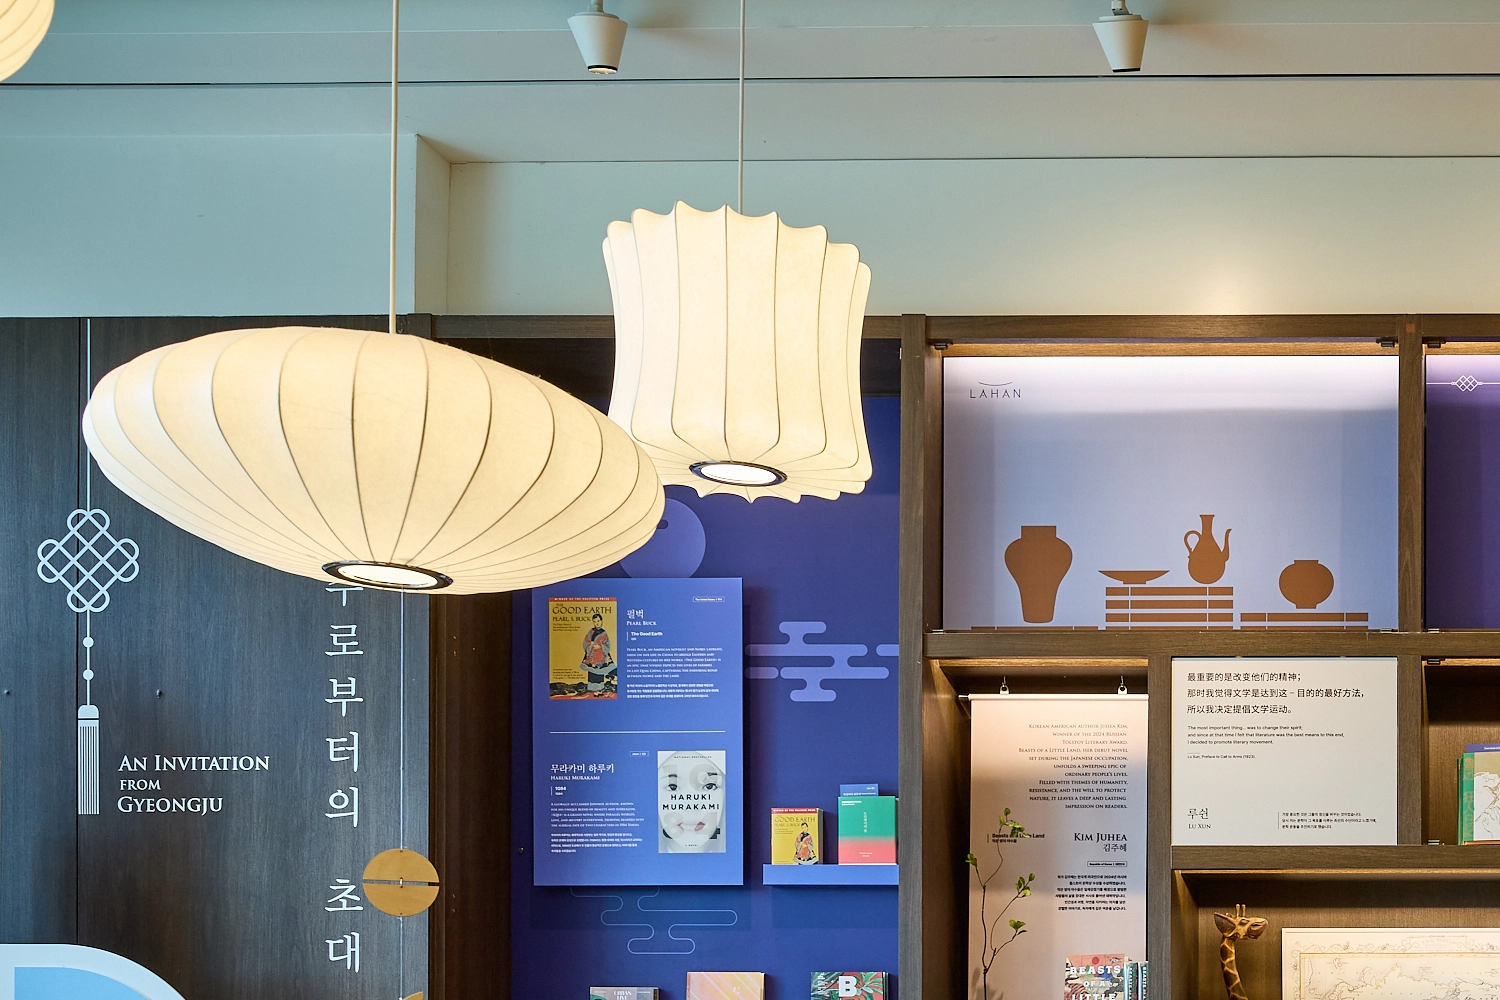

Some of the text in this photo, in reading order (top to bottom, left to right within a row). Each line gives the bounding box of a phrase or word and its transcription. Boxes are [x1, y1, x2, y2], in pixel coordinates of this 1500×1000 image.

[970, 389, 1021, 399] LAHAN
[552, 606, 612, 615] GOOD EARTH
[118, 754, 270, 772] AN INVITATION
[550, 763, 614, 774] 무라카미 하루키
[120, 779, 161, 790] FROM
[117, 796, 223, 816] GYEONGJU
[1074, 832, 1128, 842] KIM JUHEA
[1103, 843, 1127, 852] 김주혜
[325, 879, 363, 973] 초대
[1070, 966, 1121, 975] BEASTS
[838, 976, 857, 997] B
